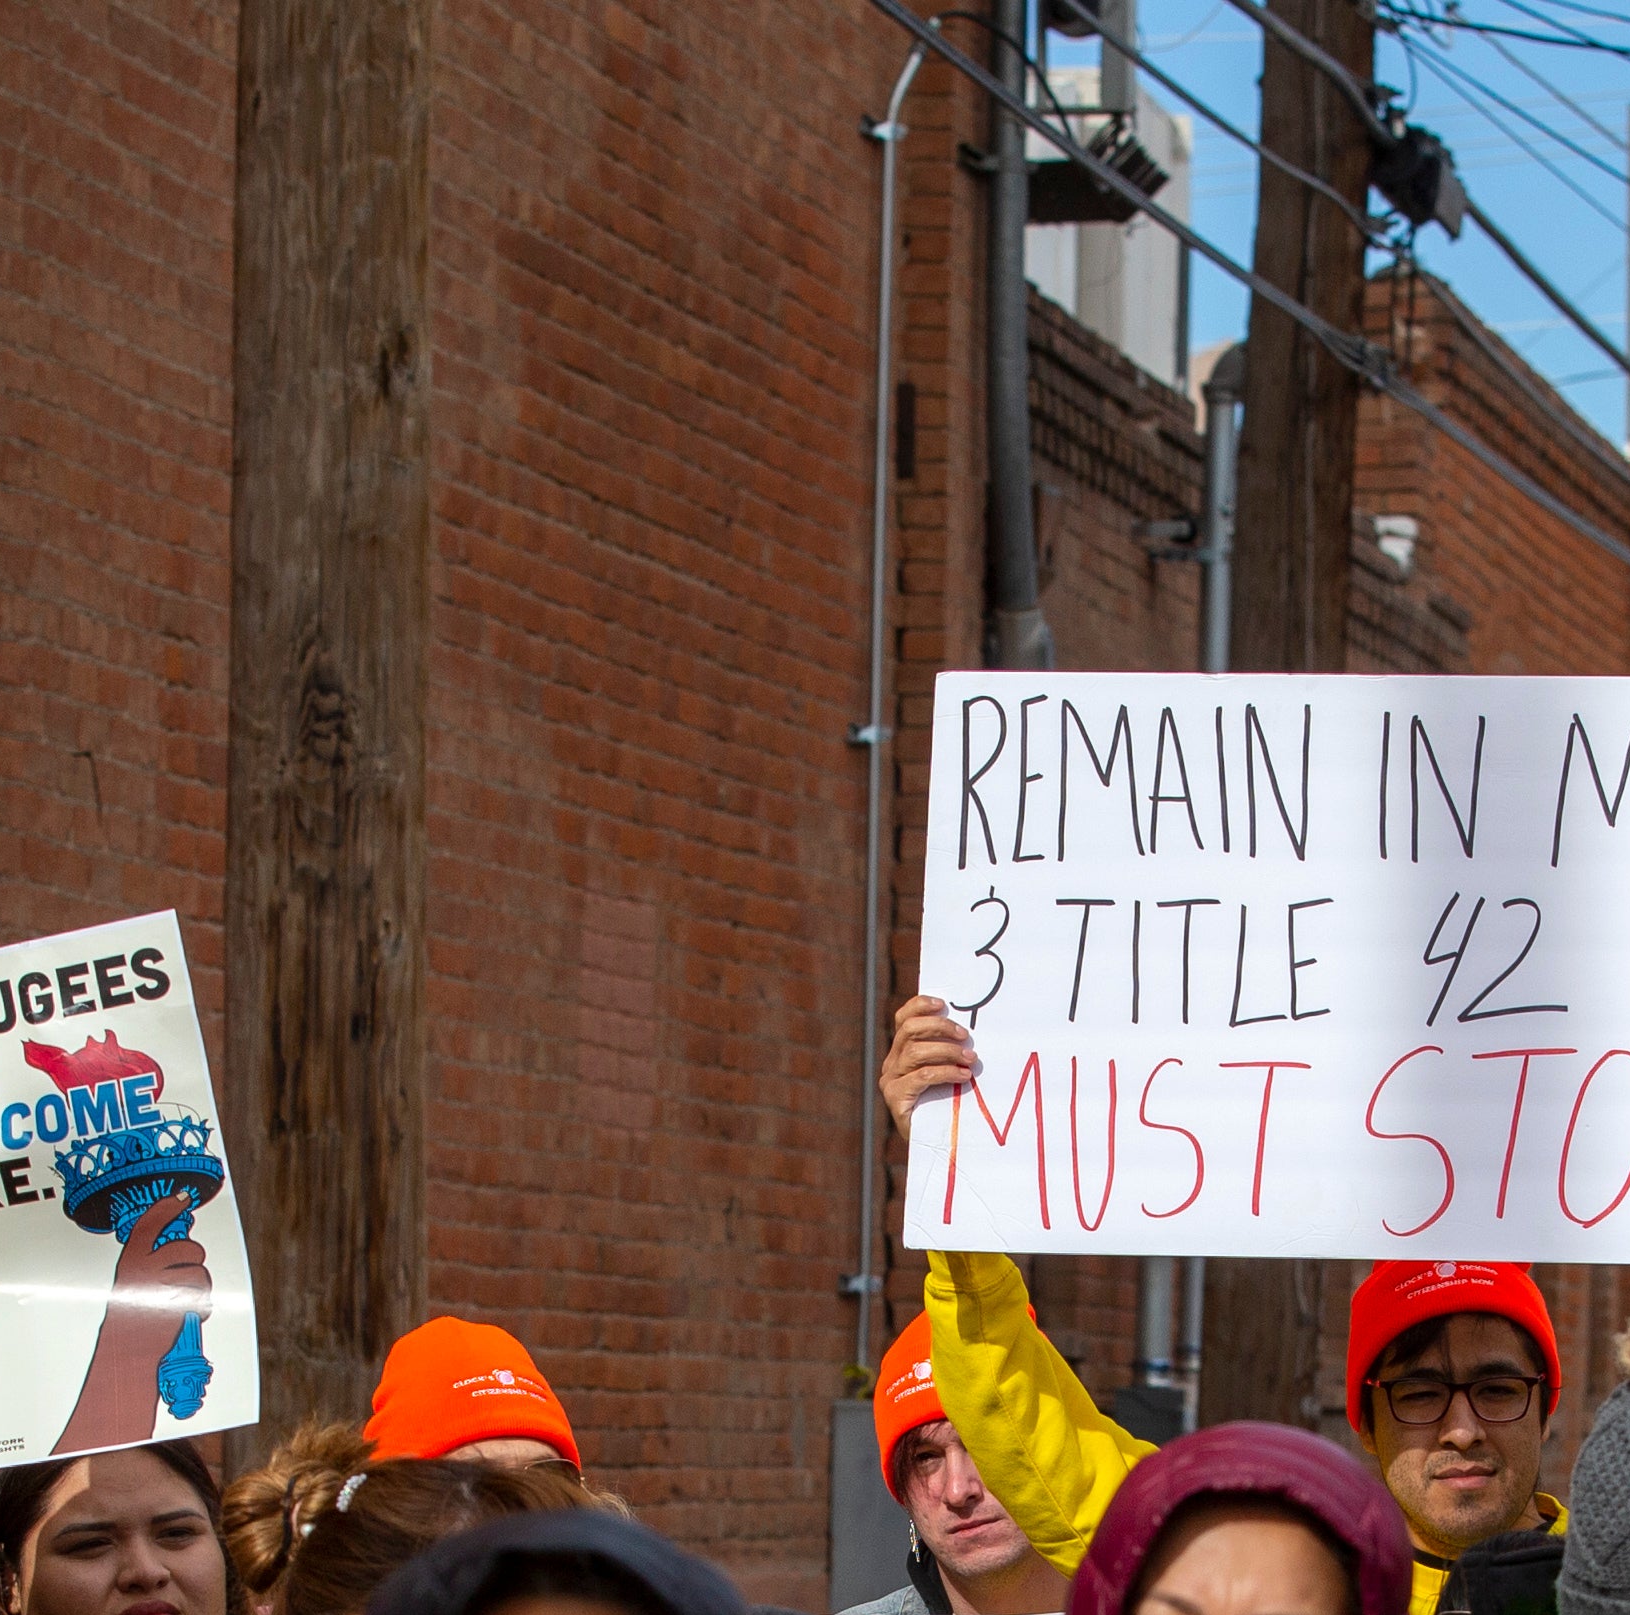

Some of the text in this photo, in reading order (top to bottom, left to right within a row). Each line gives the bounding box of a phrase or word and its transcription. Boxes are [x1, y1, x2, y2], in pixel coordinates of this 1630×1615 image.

[957, 693, 1311, 870] REMAIN
[1379, 711, 1486, 863] IN
[1056, 897, 1334, 1028] TITLE
[1423, 892, 1568, 1027] 42
[943, 1051, 1312, 1232] MUST
